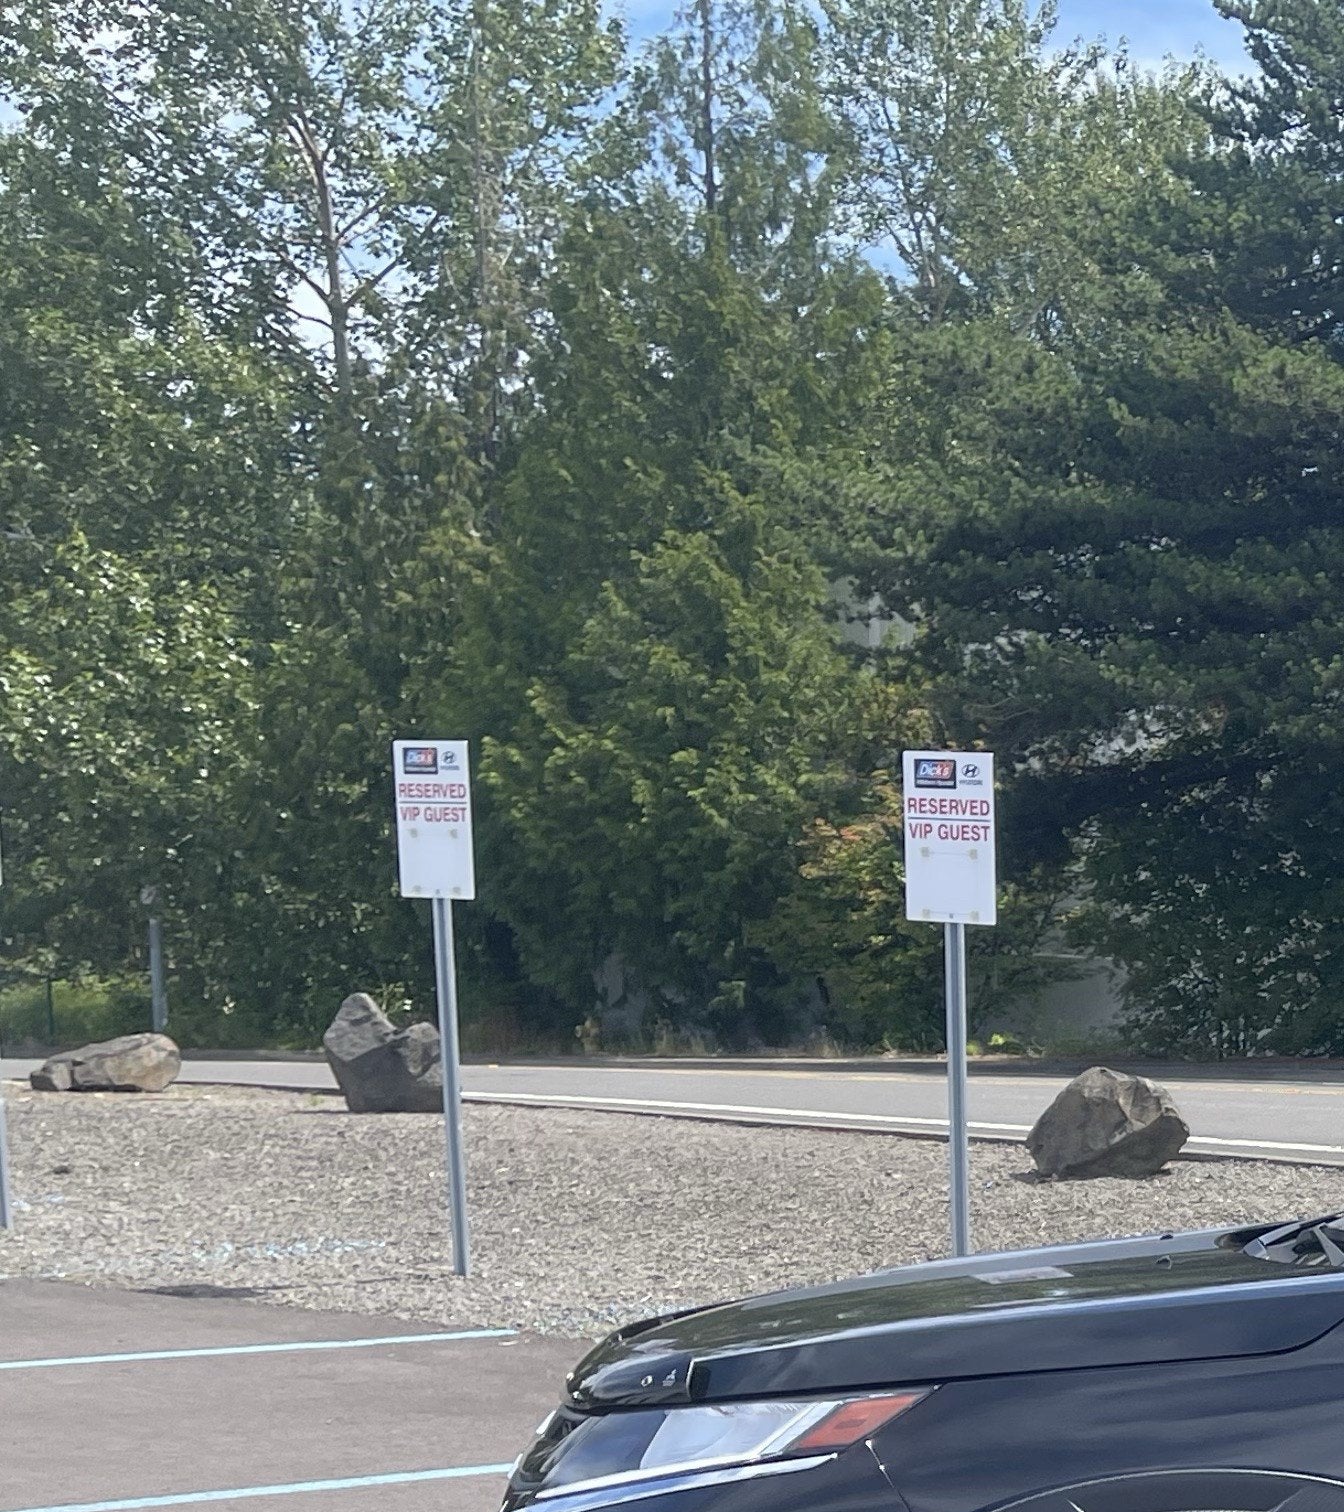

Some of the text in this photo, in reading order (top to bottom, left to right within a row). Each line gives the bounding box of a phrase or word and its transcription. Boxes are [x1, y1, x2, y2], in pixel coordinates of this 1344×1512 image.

[399, 783, 466, 799] RESERVED
[400, 807, 467, 822] VIP GUEST
[908, 798, 990, 816] RESERVED
[909, 823, 990, 842] VIP GUEST
